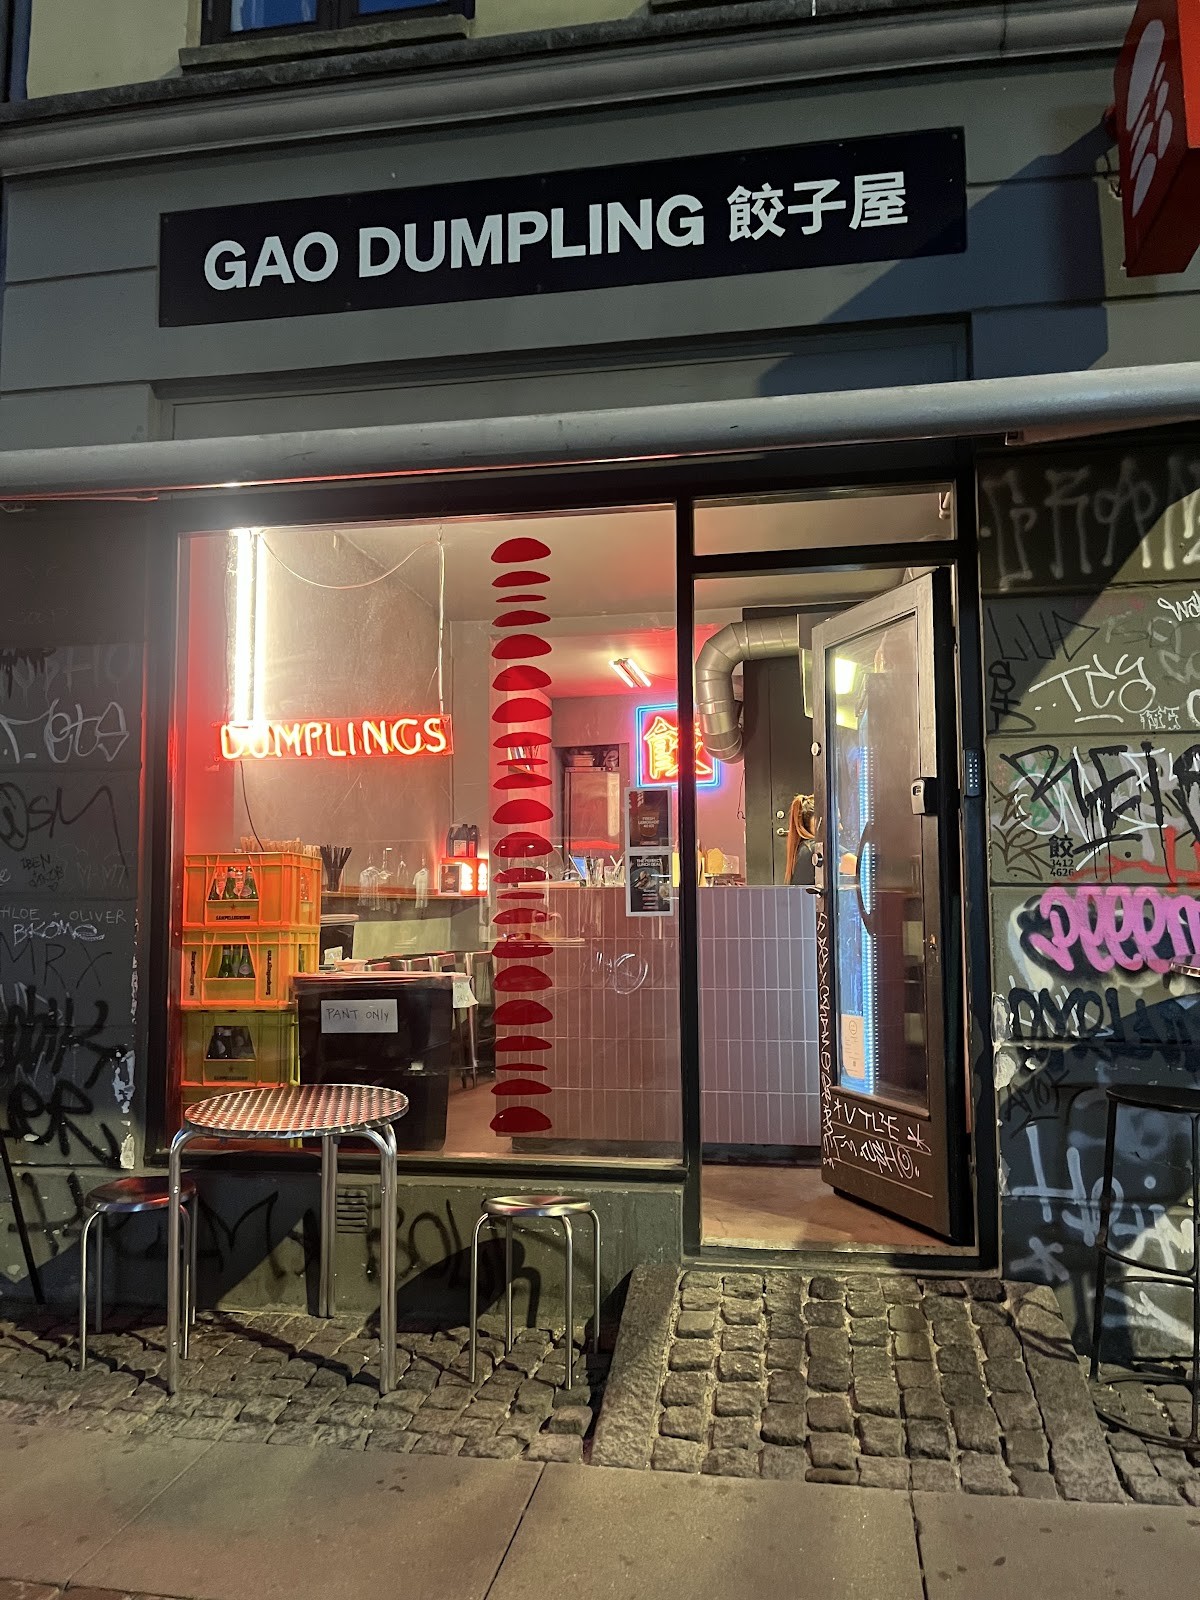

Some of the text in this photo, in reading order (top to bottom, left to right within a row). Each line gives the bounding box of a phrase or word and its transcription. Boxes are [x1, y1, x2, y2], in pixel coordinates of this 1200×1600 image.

[203, 170, 909, 291] GAO DUMPLING 餃子屋
[220, 718, 447, 760] DUMPLINGS
[1049, 834, 1074, 858] 餃
[1049, 859, 1074, 867] 3412
[69, 909, 127, 925] OLIVER
[326, 1008, 359, 1020] PANT
